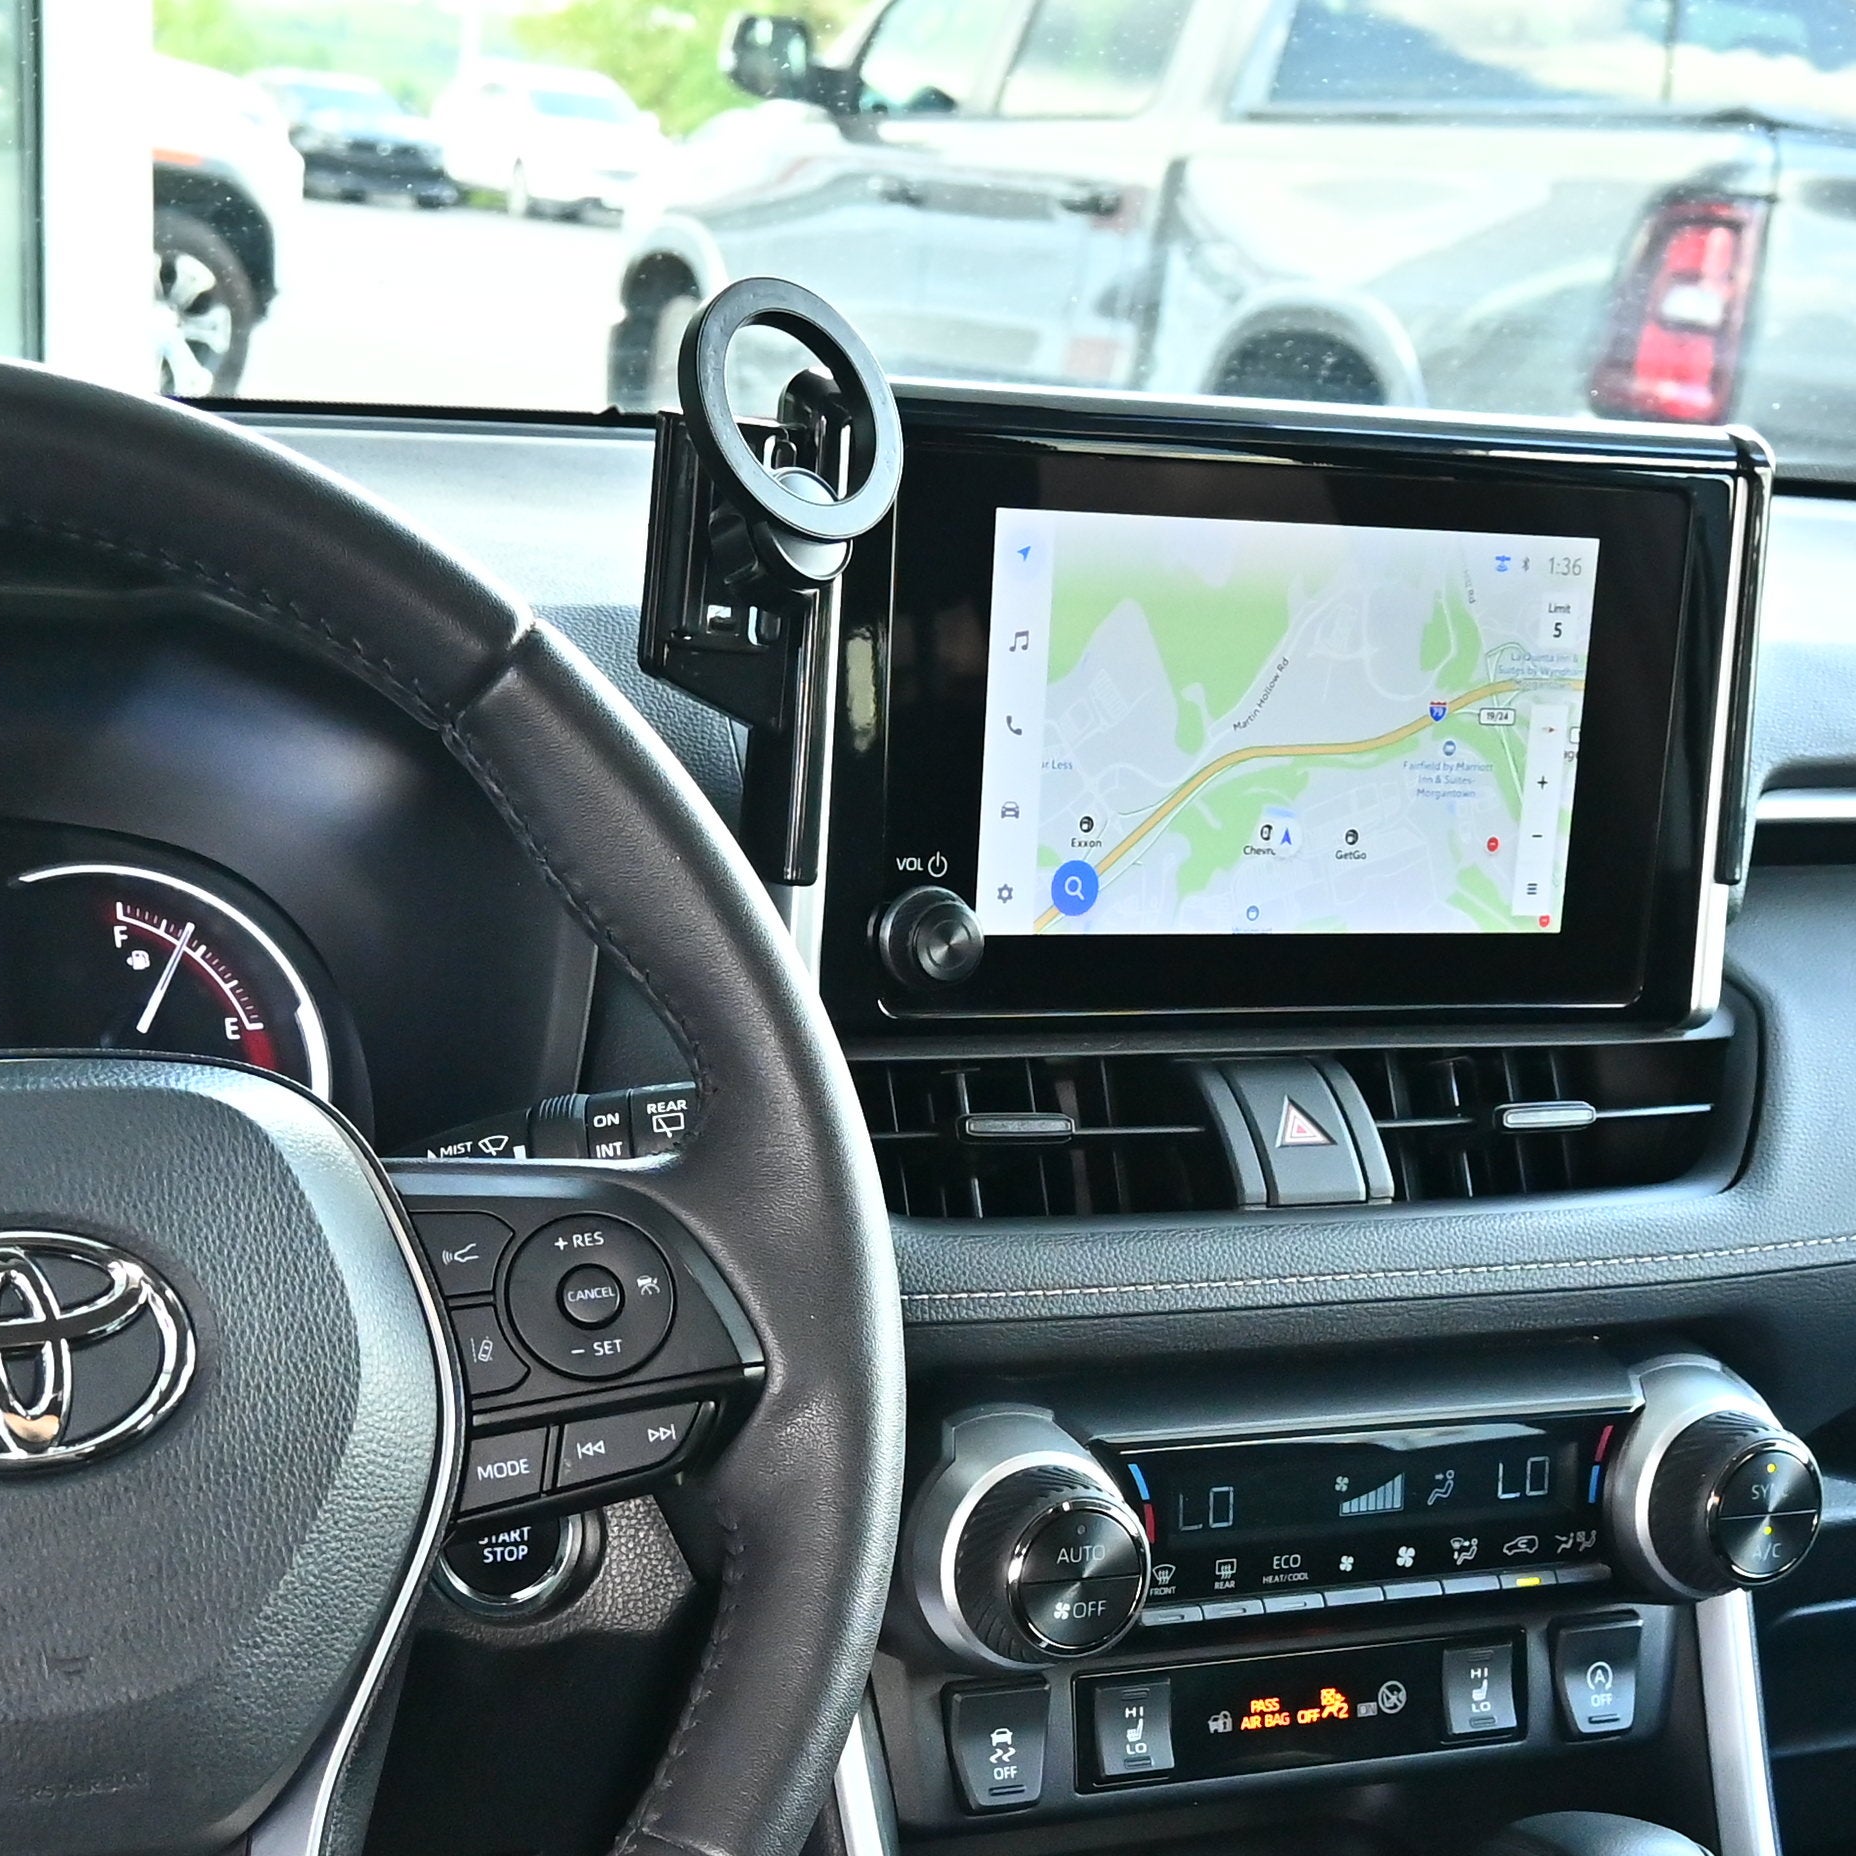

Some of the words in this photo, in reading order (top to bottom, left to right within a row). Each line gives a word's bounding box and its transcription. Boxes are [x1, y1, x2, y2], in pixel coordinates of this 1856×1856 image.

[1548, 556, 1582, 577] 1:36
[1548, 603, 1571, 614] Limit
[1552, 621, 1563, 638] 5
[1233, 707, 1260, 733] Martin
[1257, 672, 1282, 709] Hollow
[1276, 657, 1289, 674] Rd
[1486, 711, 1509, 722] 19/24
[1402, 761, 1441, 772] Fairfield
[1416, 788, 1477, 800] Morgantown
[1071, 837, 1102, 848] Exxon
[1335, 849, 1367, 861] GetGo
[896, 856, 924, 872] VOL
[113, 925, 128, 948] F
[224, 1016, 241, 1040] E
[646, 1099, 688, 1115] REAR
[593, 1112, 620, 1129] ON
[439, 1141, 473, 1157] MIST
[595, 1141, 623, 1159] INT
[567, 1286, 617, 1303] CANCEL
[592, 1338, 624, 1357] SET
[476, 1457, 531, 1482] MODE
[482, 1547, 529, 1563] STOP
[1055, 1545, 1105, 1565] AUTO
[1752, 1542, 1783, 1561] A/C
[1272, 1554, 1302, 1569] ECO
[1214, 1579, 1236, 1590] REAR
[1262, 1571, 1310, 1584] HEAT/COOL
[1149, 1584, 1176, 1596] FRONT
[1072, 1600, 1107, 1619] OFF
[1470, 1667, 1489, 1679] HI
[1250, 1697, 1280, 1714] PASS
[1471, 1701, 1492, 1713] LO
[1590, 1693, 1613, 1708] OFF
[1124, 1706, 1145, 1719] HI
[1240, 1714, 1262, 1731] AIR
[1264, 1712, 1290, 1728] BAG
[1296, 1708, 1321, 1725] OFF
[1125, 1742, 1147, 1755] LO
[993, 1766, 1019, 1781] OFF
